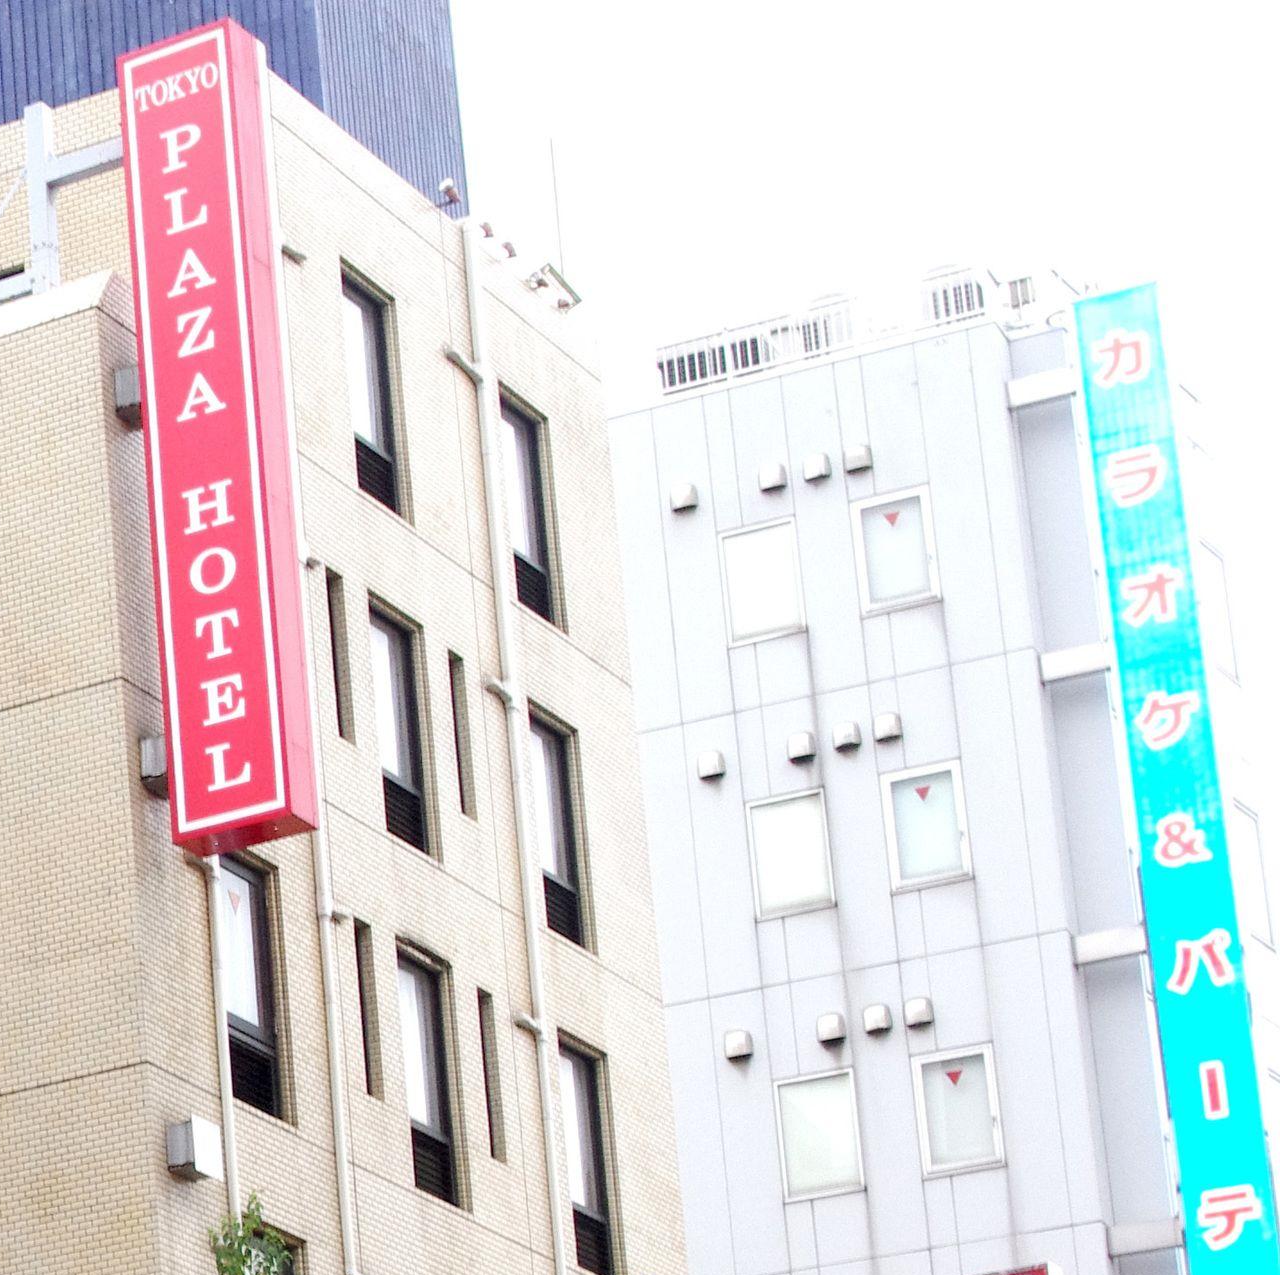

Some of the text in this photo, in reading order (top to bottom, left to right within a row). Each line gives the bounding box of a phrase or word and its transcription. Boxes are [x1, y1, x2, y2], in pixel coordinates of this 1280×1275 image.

[134, 62, 219, 112] TOKYO
[159, 123, 252, 792] PLAZA HOTEL
